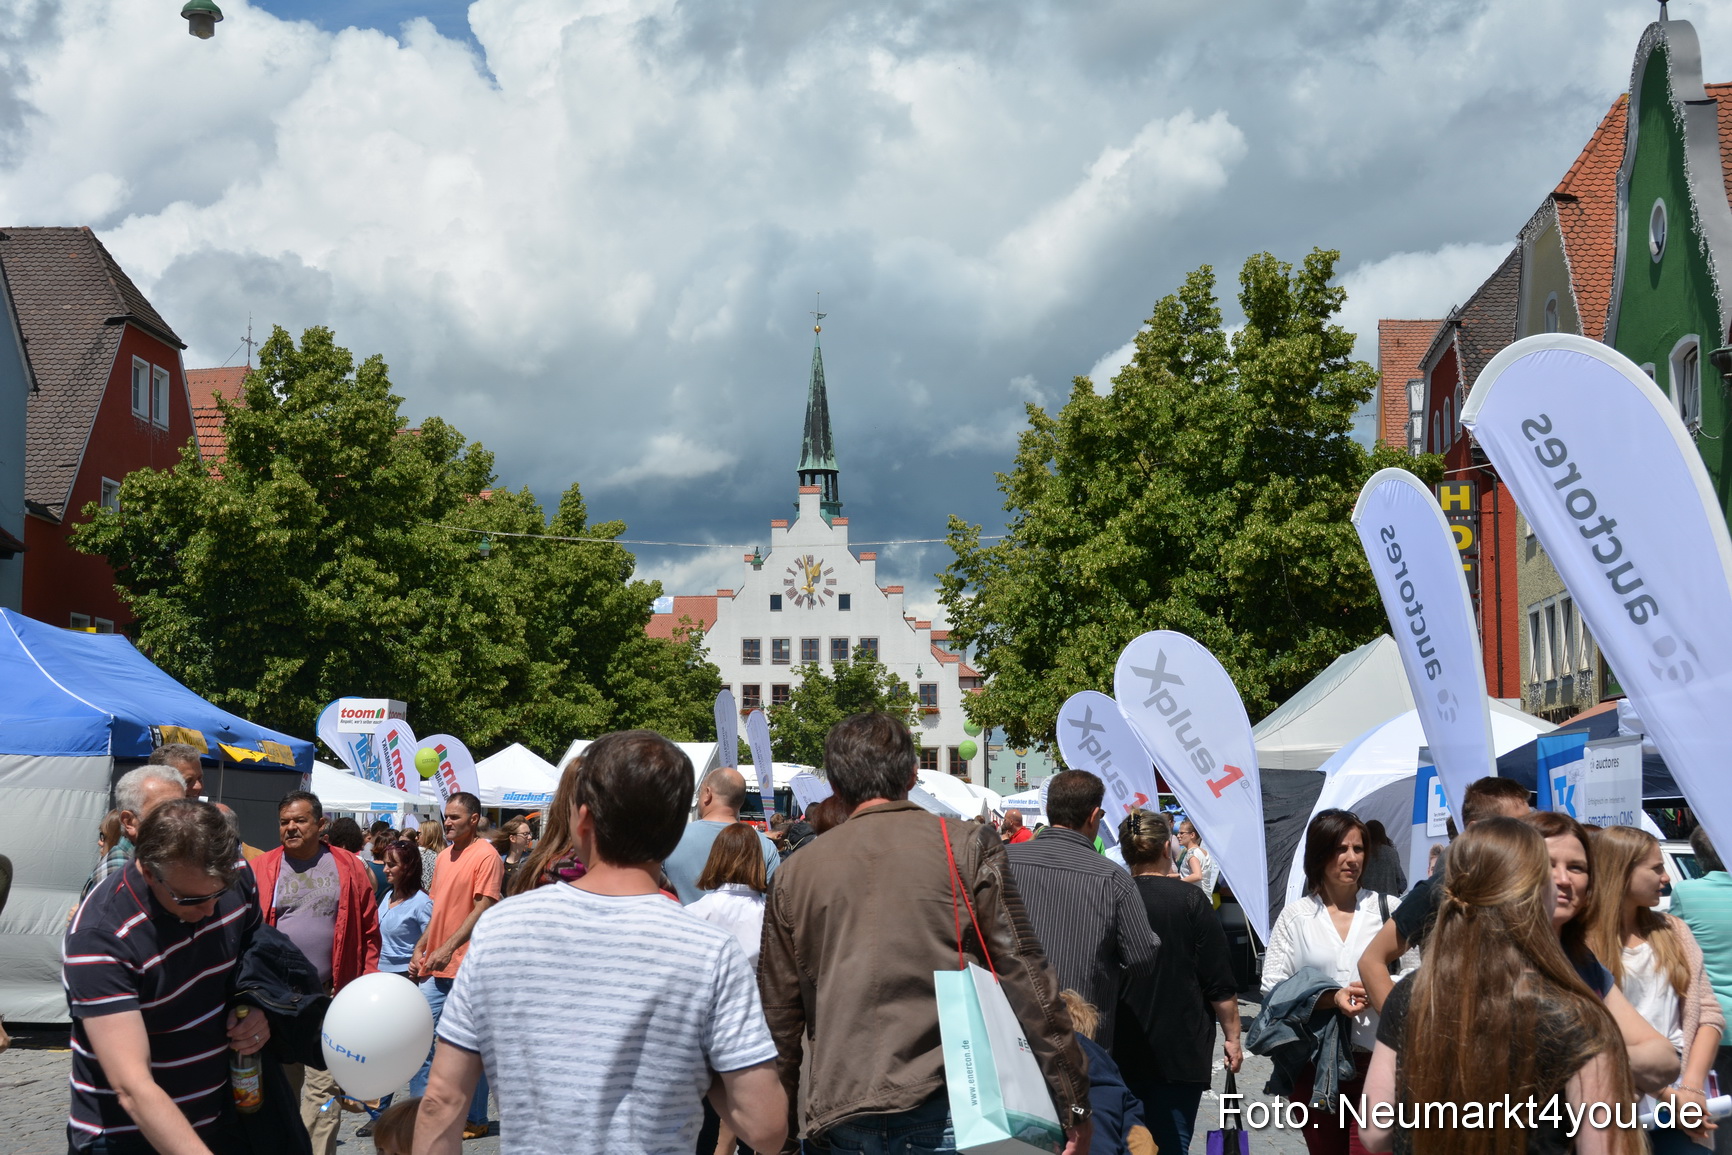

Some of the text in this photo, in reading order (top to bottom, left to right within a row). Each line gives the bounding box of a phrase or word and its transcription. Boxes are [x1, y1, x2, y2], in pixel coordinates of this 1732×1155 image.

[341, 708, 376, 719] toom
[1595, 757, 1620, 769] auctores
[1620, 810, 1634, 825] CMS
[322, 1032, 366, 1064] ELPHI
[961, 1039, 977, 1106] www.enercon.de
